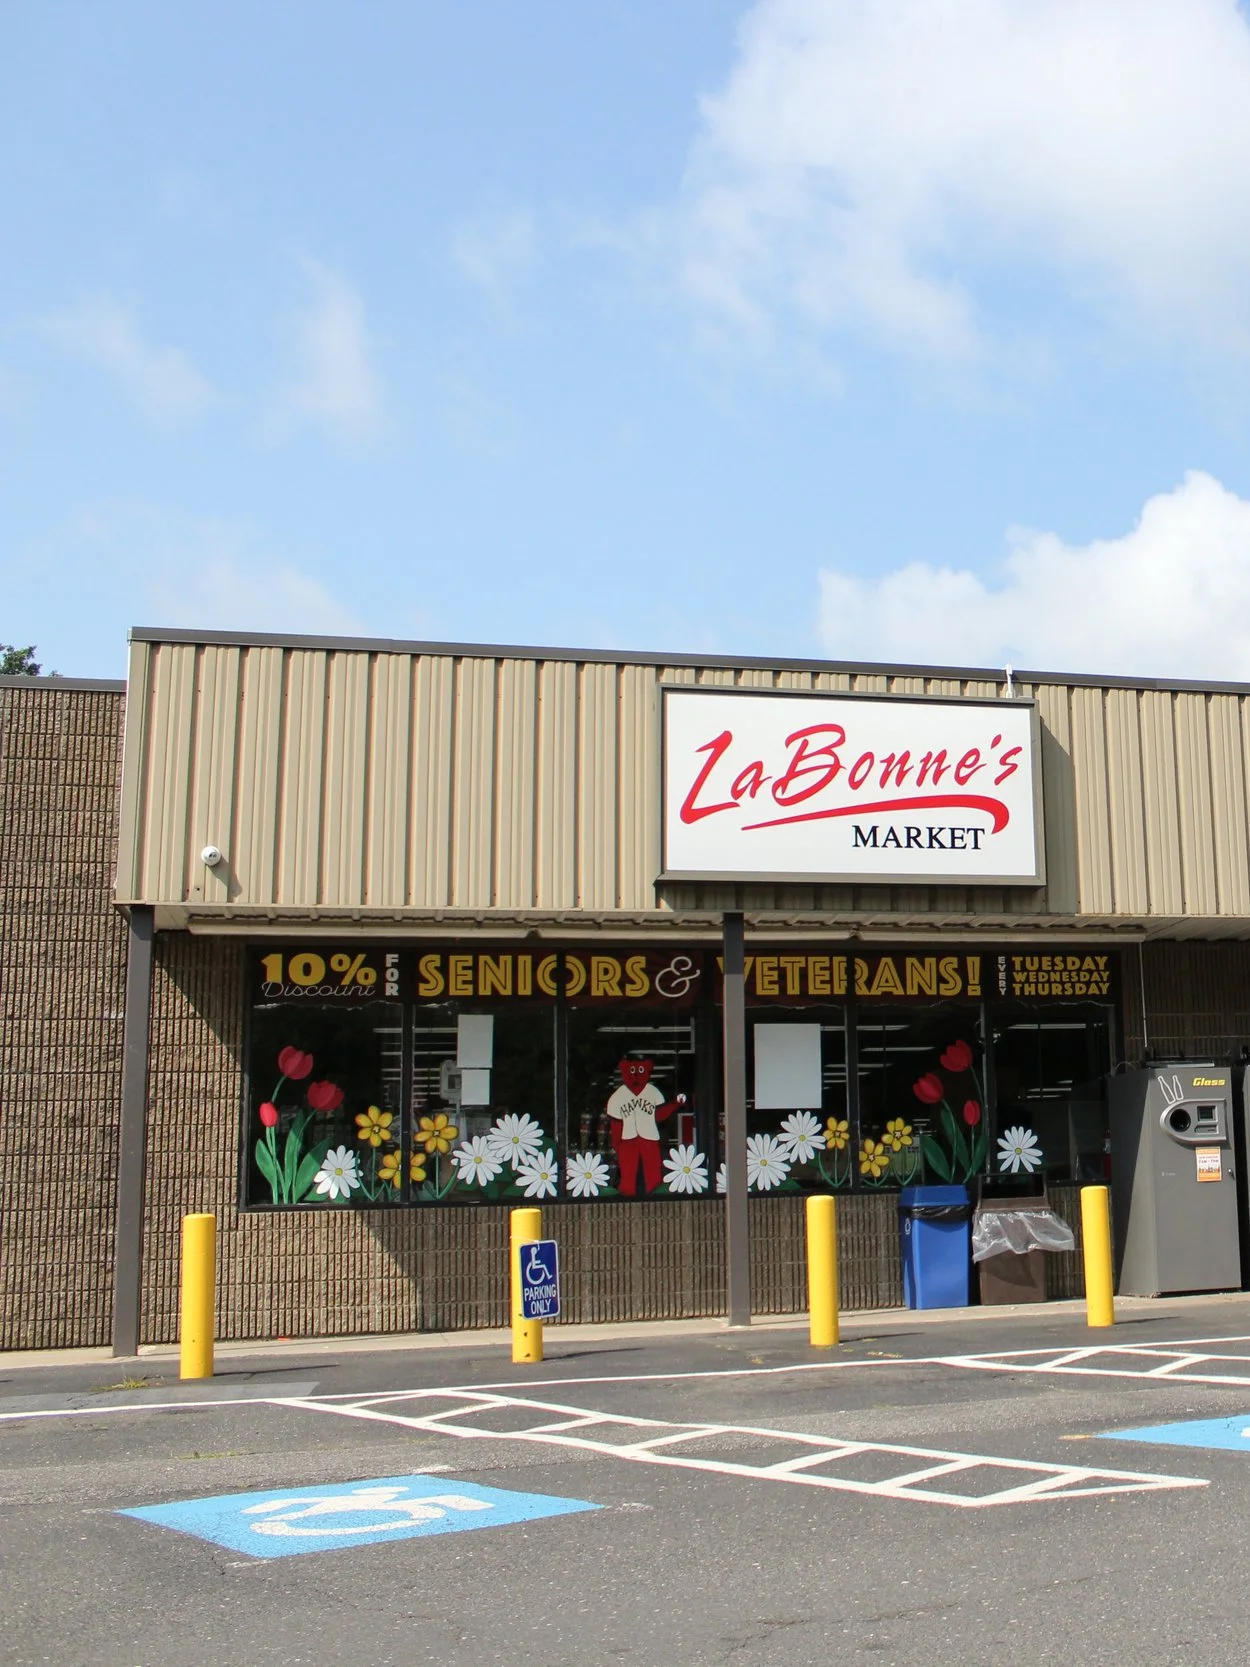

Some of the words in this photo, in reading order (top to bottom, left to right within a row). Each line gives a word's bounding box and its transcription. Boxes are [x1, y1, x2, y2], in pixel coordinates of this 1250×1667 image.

[680, 723, 1023, 824] LaBonne's
[852, 825, 985, 850] MARKET
[261, 953, 377, 986] 10%
[1011, 956, 1109, 971] TUESDAY
[385, 953, 400, 997] FOR
[418, 954, 652, 997] SENIORS
[655, 956, 700, 998] &
[998, 956, 1007, 996] EVERY
[1012, 971, 1110, 982] WEDNESDAY
[261, 981, 376, 997] Discount
[1012, 982, 1110, 996] THURSDAY
[1193, 1077, 1226, 1087] Glass
[620, 1098, 655, 1118] HAWKS
[524, 1284, 556, 1302] PARKING
[530, 1298, 551, 1315] ONLY
